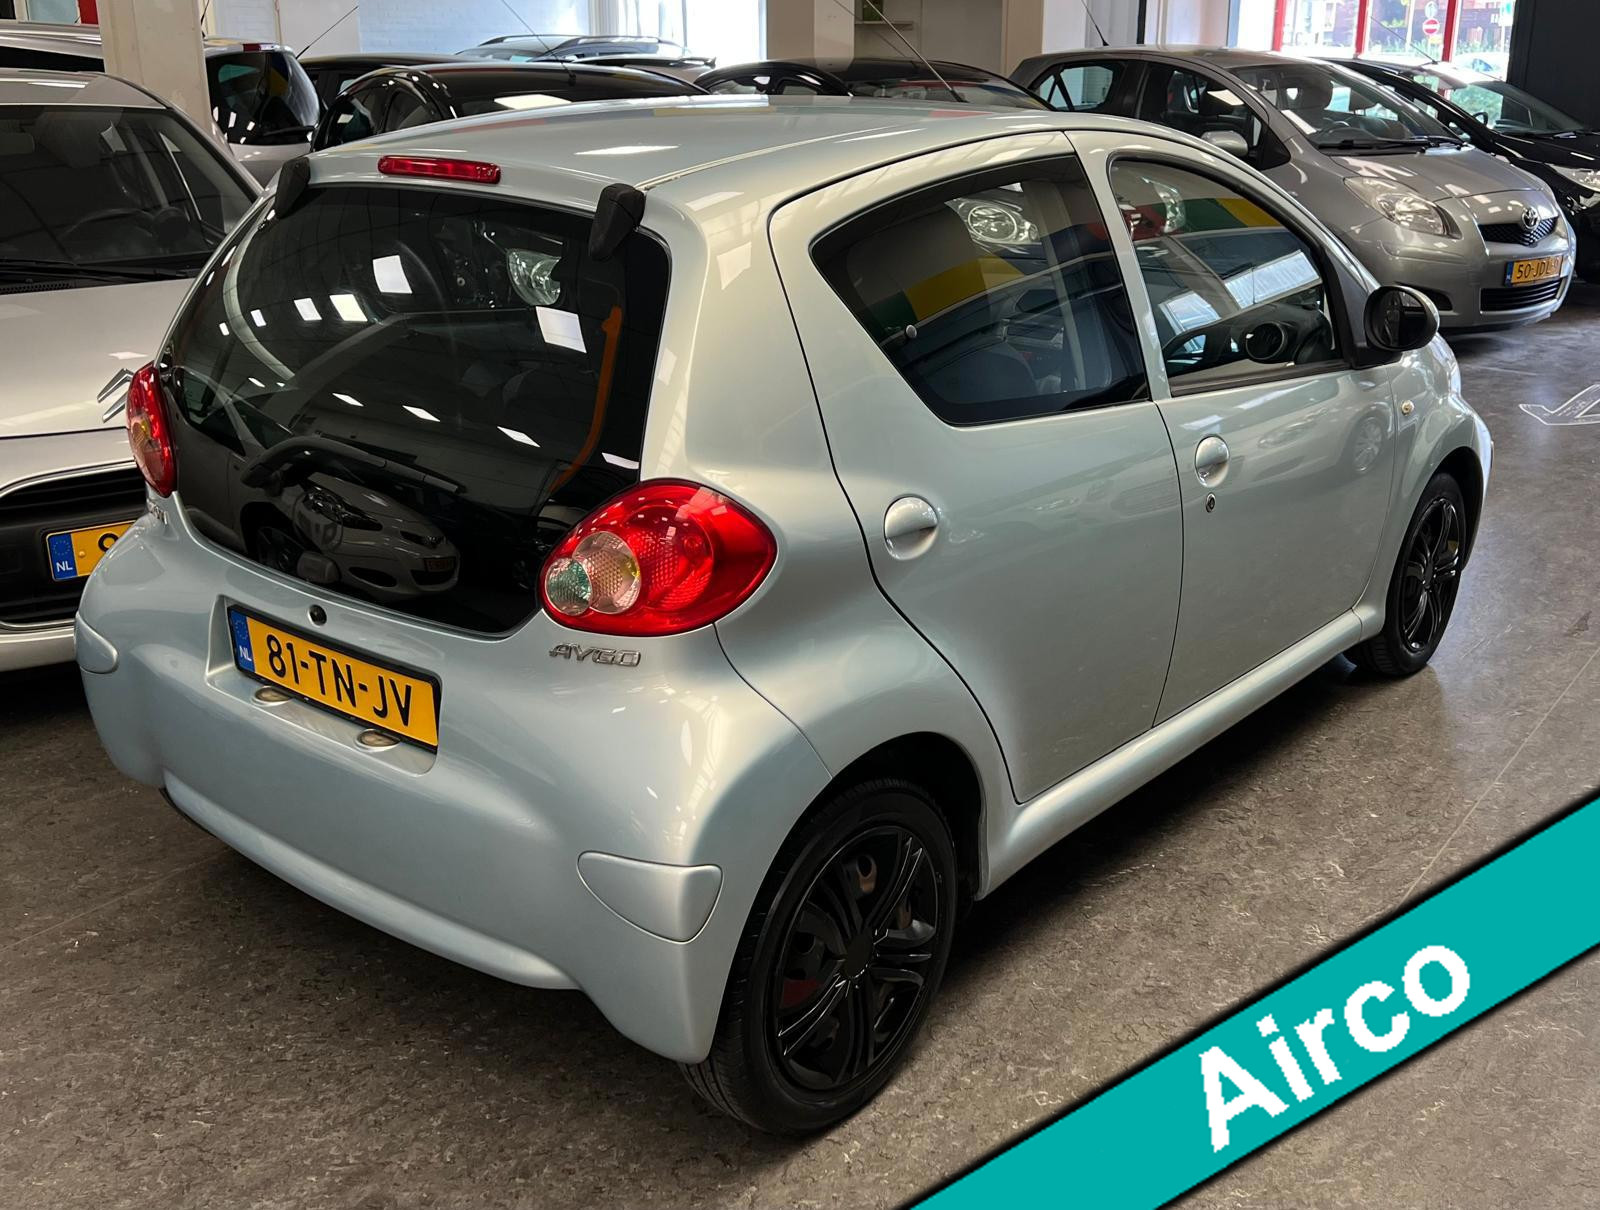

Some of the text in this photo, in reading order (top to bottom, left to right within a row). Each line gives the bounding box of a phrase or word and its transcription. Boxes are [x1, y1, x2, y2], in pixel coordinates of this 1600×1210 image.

[56, 560, 73, 573] NL
[239, 645, 252, 662] NL
[549, 642, 642, 667] AYGO
[266, 633, 412, 727] 81-TN-JV
